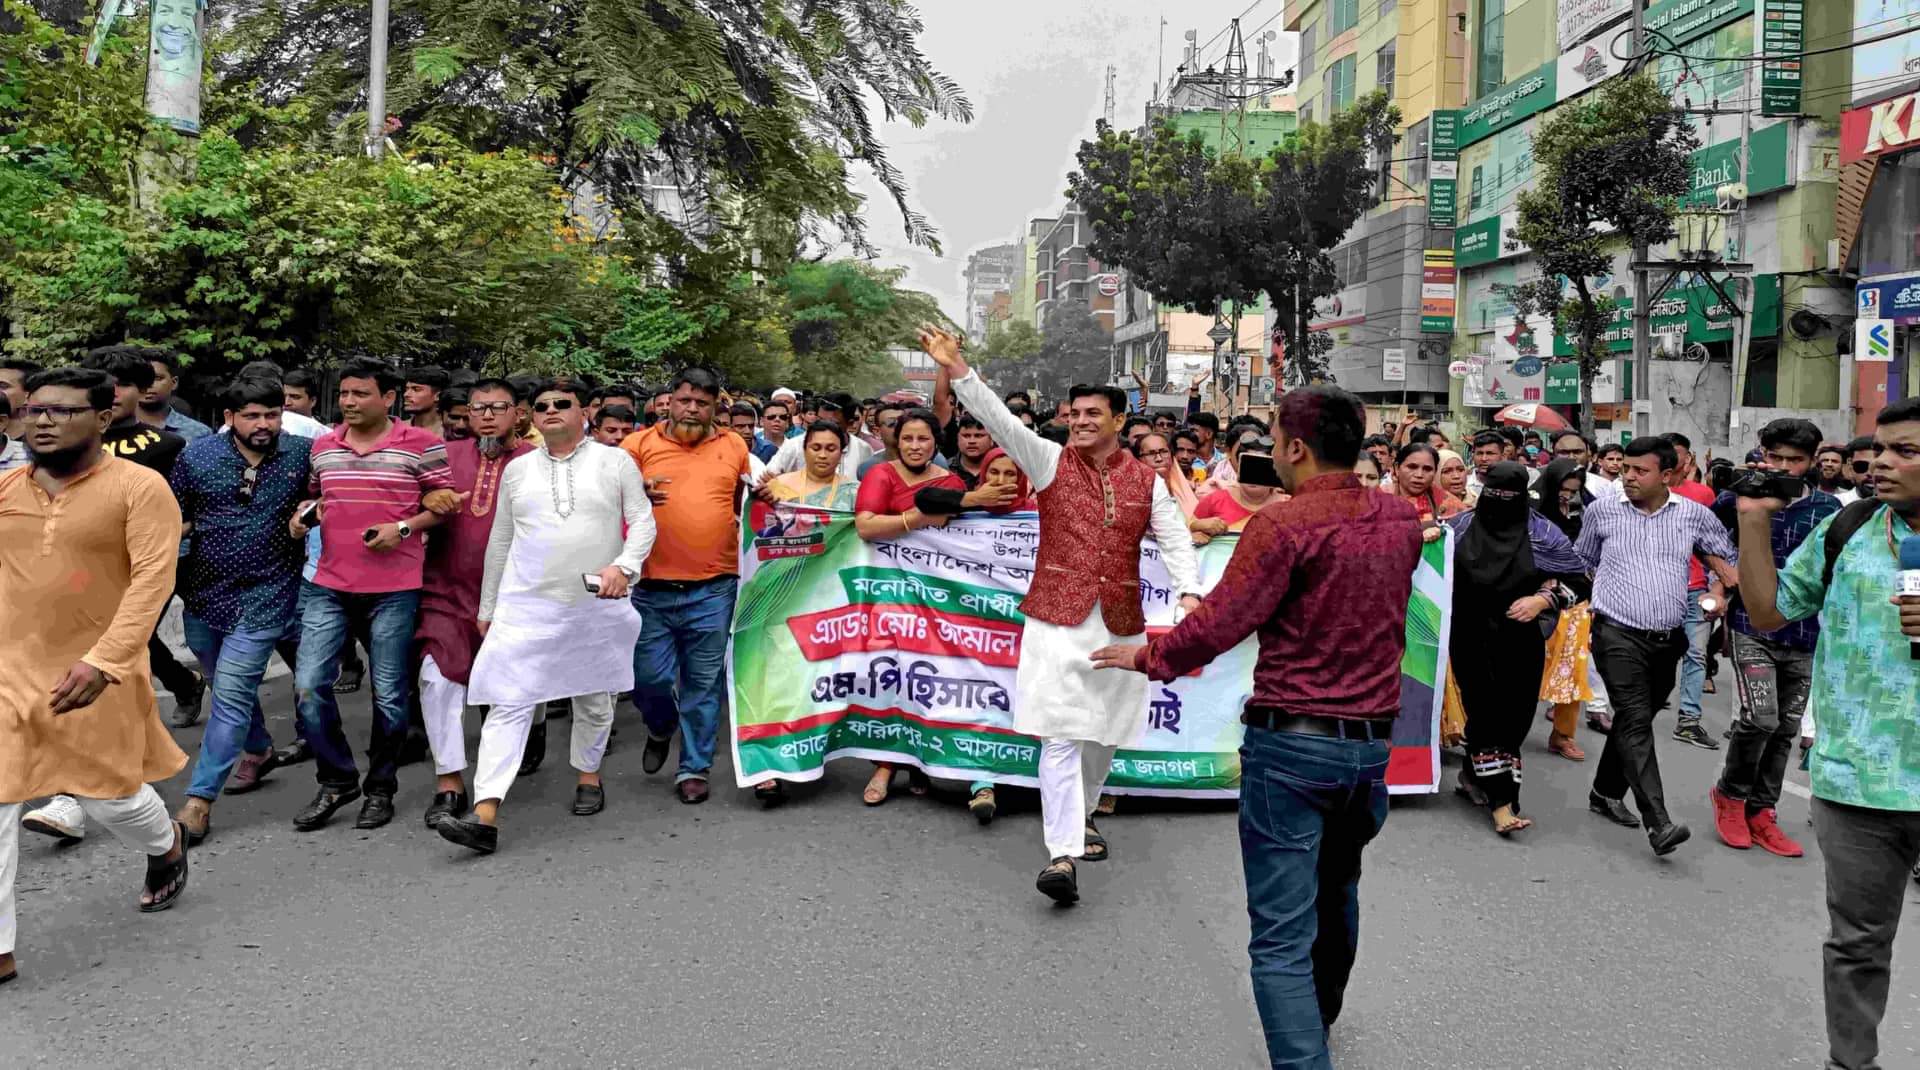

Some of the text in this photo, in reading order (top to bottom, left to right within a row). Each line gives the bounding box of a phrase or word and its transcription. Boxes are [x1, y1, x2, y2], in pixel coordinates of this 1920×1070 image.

[1694, 160, 1732, 190] Bank
[1648, 319, 1688, 338] Limited
[874, 541, 994, 580] বাংলাদেশ
[853, 576, 1020, 619] মনোনীত প্রার্থী
[878, 611, 928, 640] মোঃ
[1148, 687, 1183, 735] াই
[952, 736, 1036, 762] আসনের
[1131, 757, 1200, 777] জনগণ
